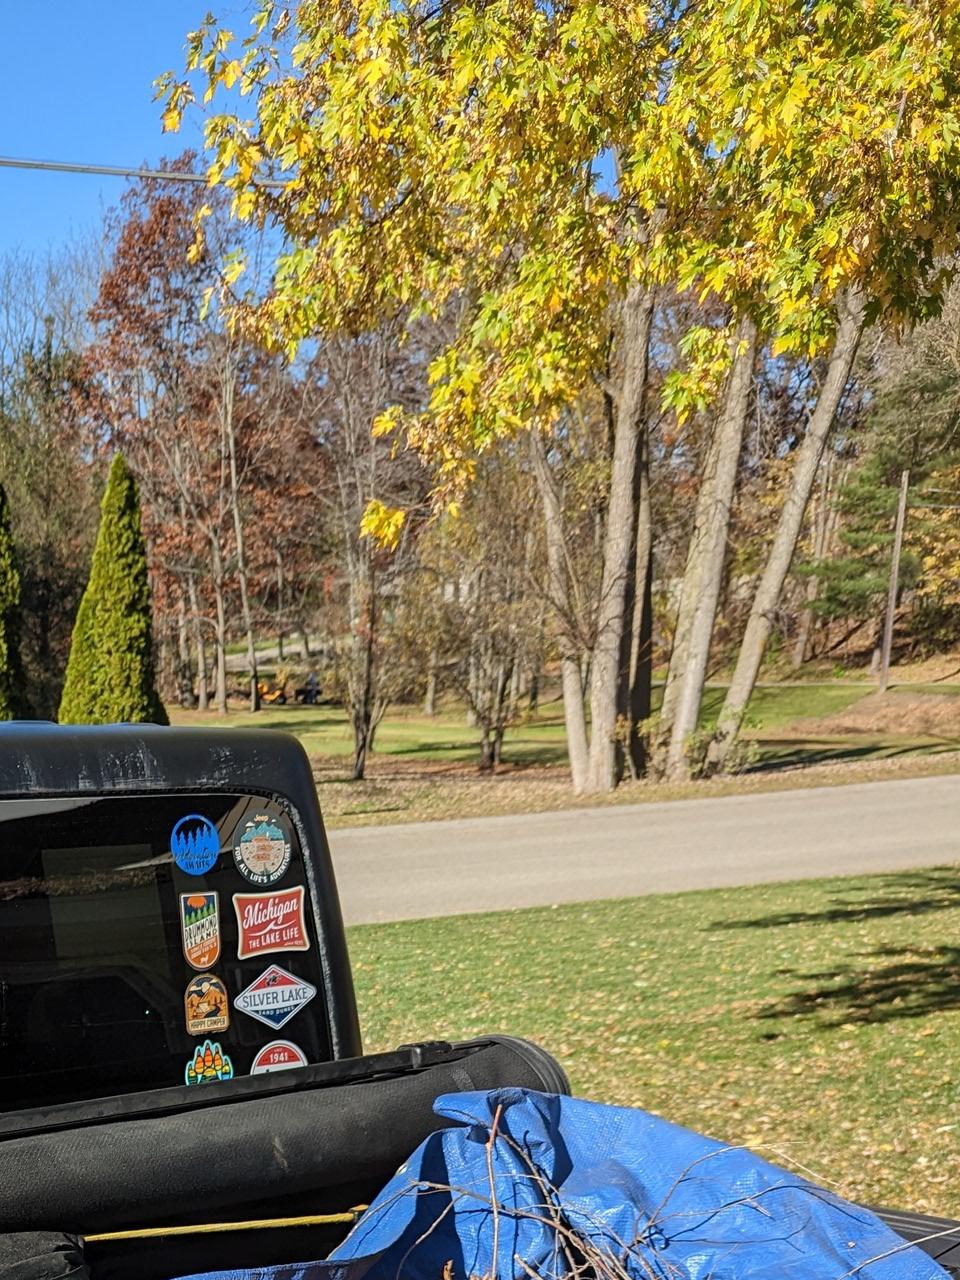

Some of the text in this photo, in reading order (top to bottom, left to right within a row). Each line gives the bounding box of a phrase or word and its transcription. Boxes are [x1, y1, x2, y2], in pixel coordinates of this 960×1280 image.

[239, 863, 249, 876] ALL
[249, 874, 268, 883] LIFE'S
[243, 898, 298, 929] Michigan
[249, 938, 260, 949] THE
[261, 931, 281, 946] LAKE
[282, 926, 300, 941] LIFE
[242, 987, 309, 1009] SILVER LAKE
[270, 1052, 289, 1063] 1941
